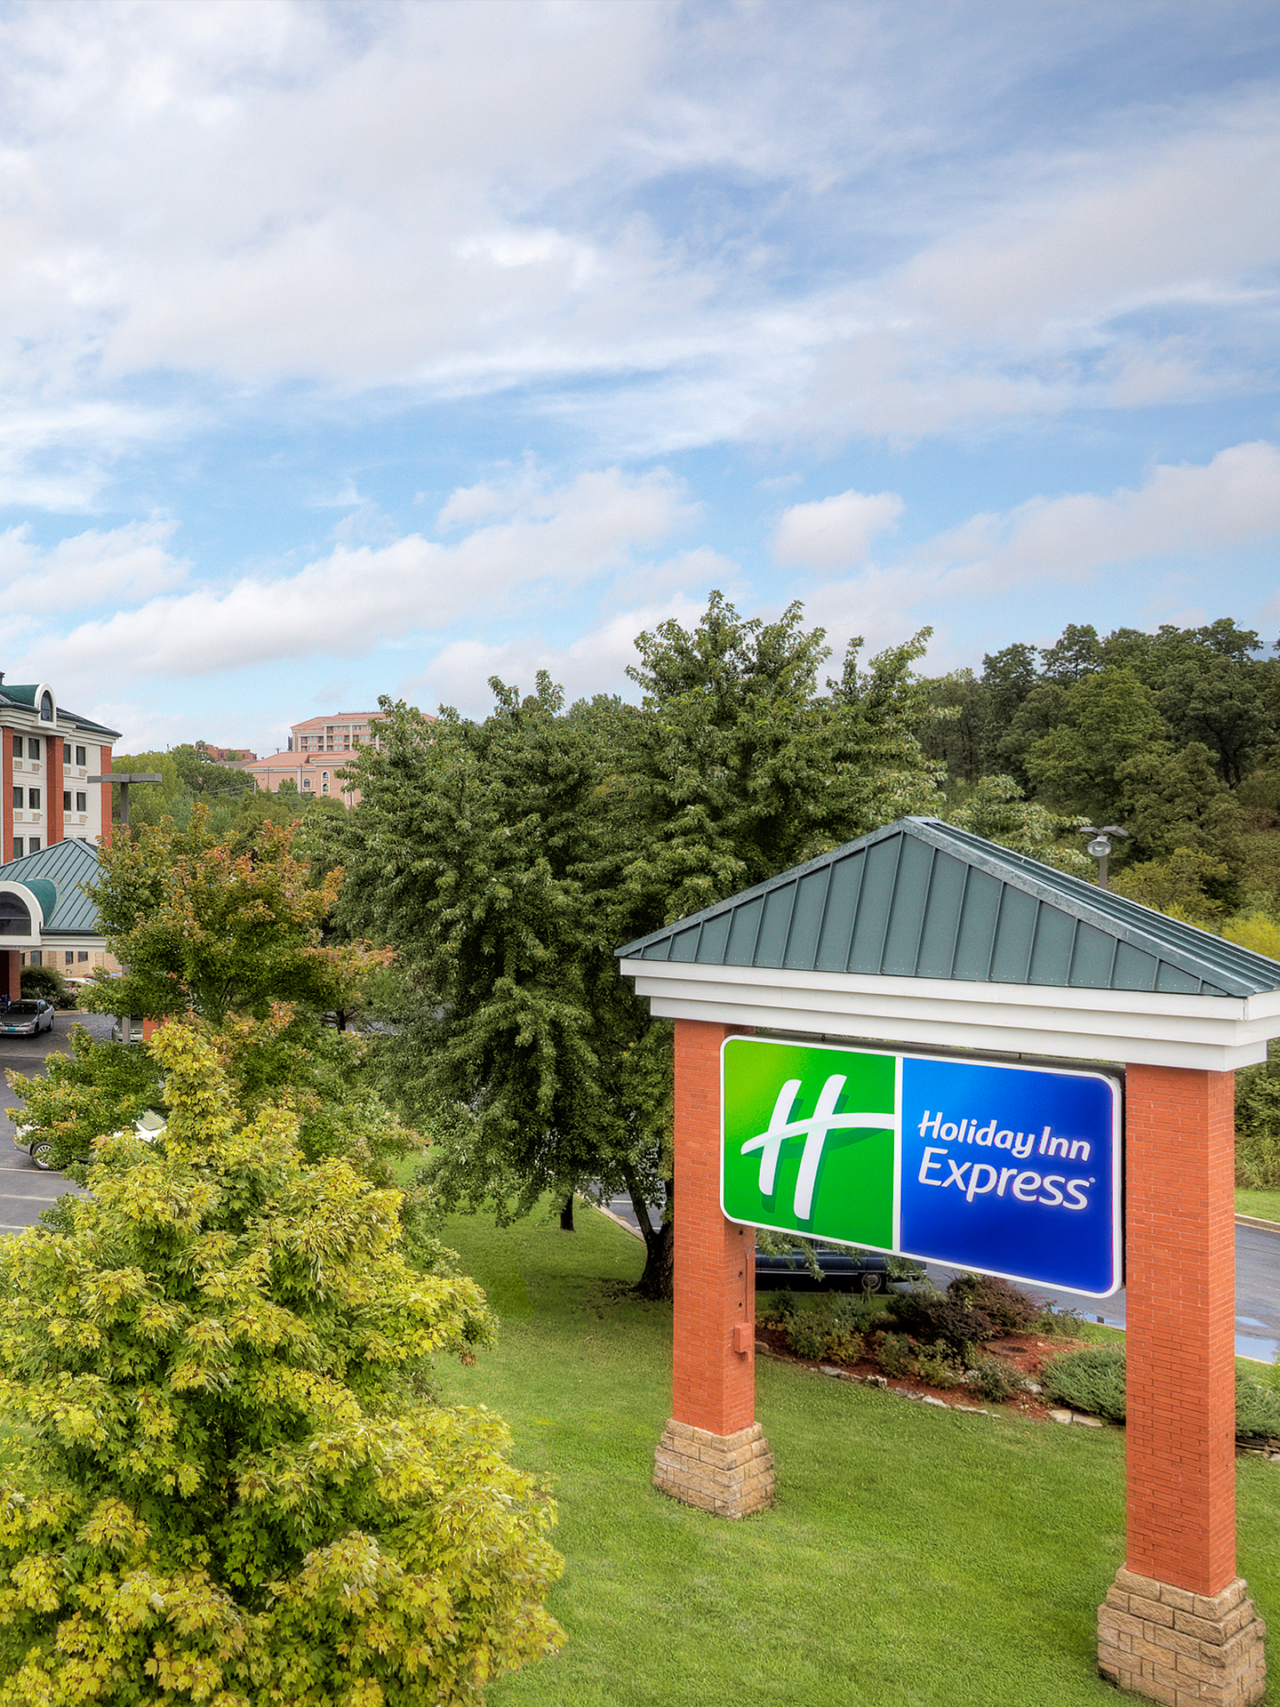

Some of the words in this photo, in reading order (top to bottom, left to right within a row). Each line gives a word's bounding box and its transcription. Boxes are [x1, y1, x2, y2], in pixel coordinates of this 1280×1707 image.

[918, 1110, 1035, 1158] Holiday
[1038, 1126, 1091, 1161] Inn
[918, 1146, 1090, 1210] Express
